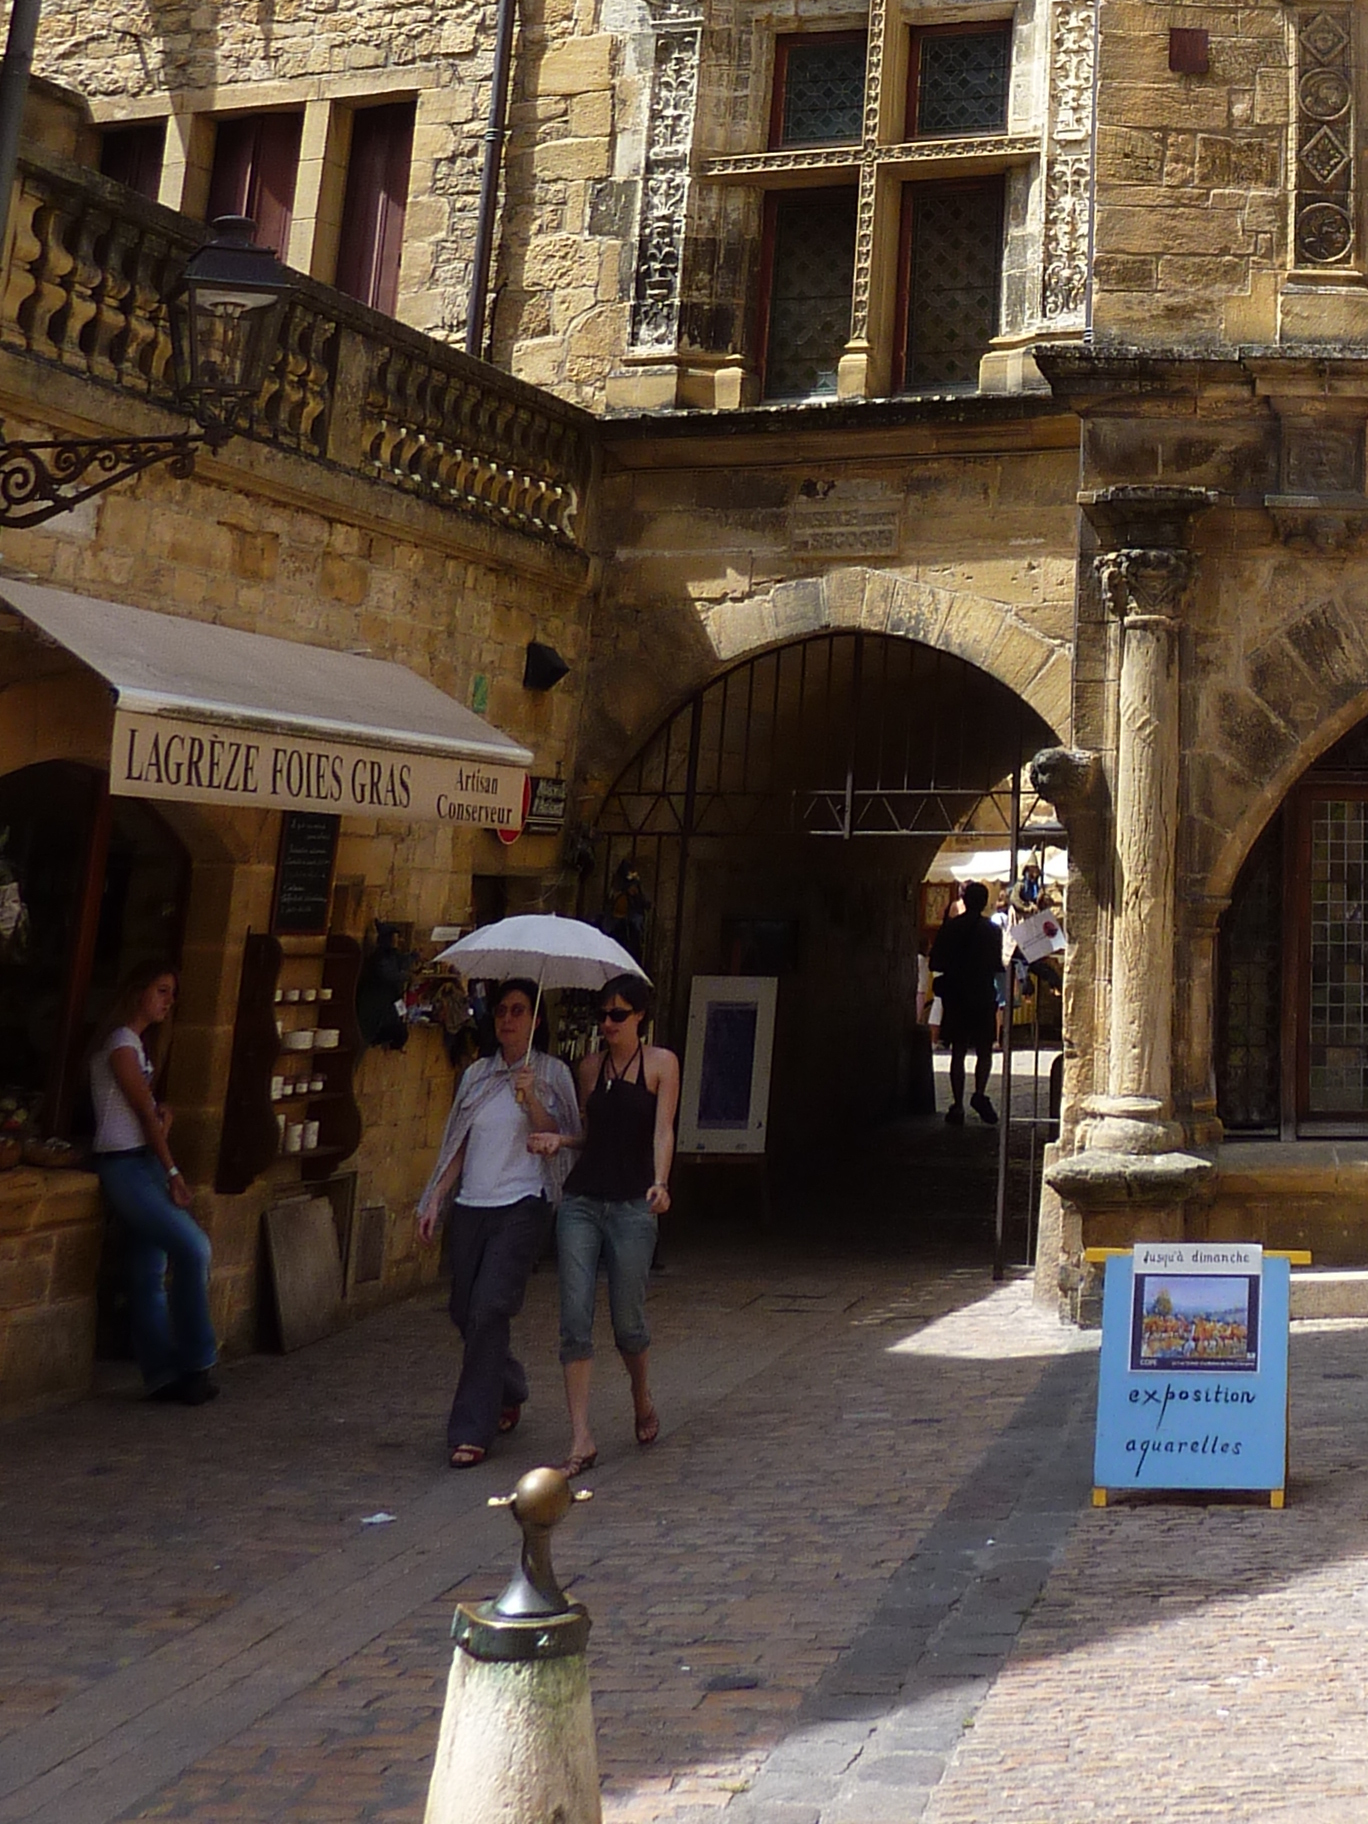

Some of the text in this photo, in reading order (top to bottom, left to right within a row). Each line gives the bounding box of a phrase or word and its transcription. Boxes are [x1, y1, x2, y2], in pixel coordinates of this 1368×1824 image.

[125, 728, 411, 809] LAGRÈZE FOIES GRAS
[454, 766, 499, 795] Artisan
[436, 793, 513, 825] Conserveur
[1143, 1250, 1250, 1267] Jusqu'à dimanche
[1129, 1383, 1256, 1431] exposition
[1125, 1434, 1243, 1478] aquarelles
